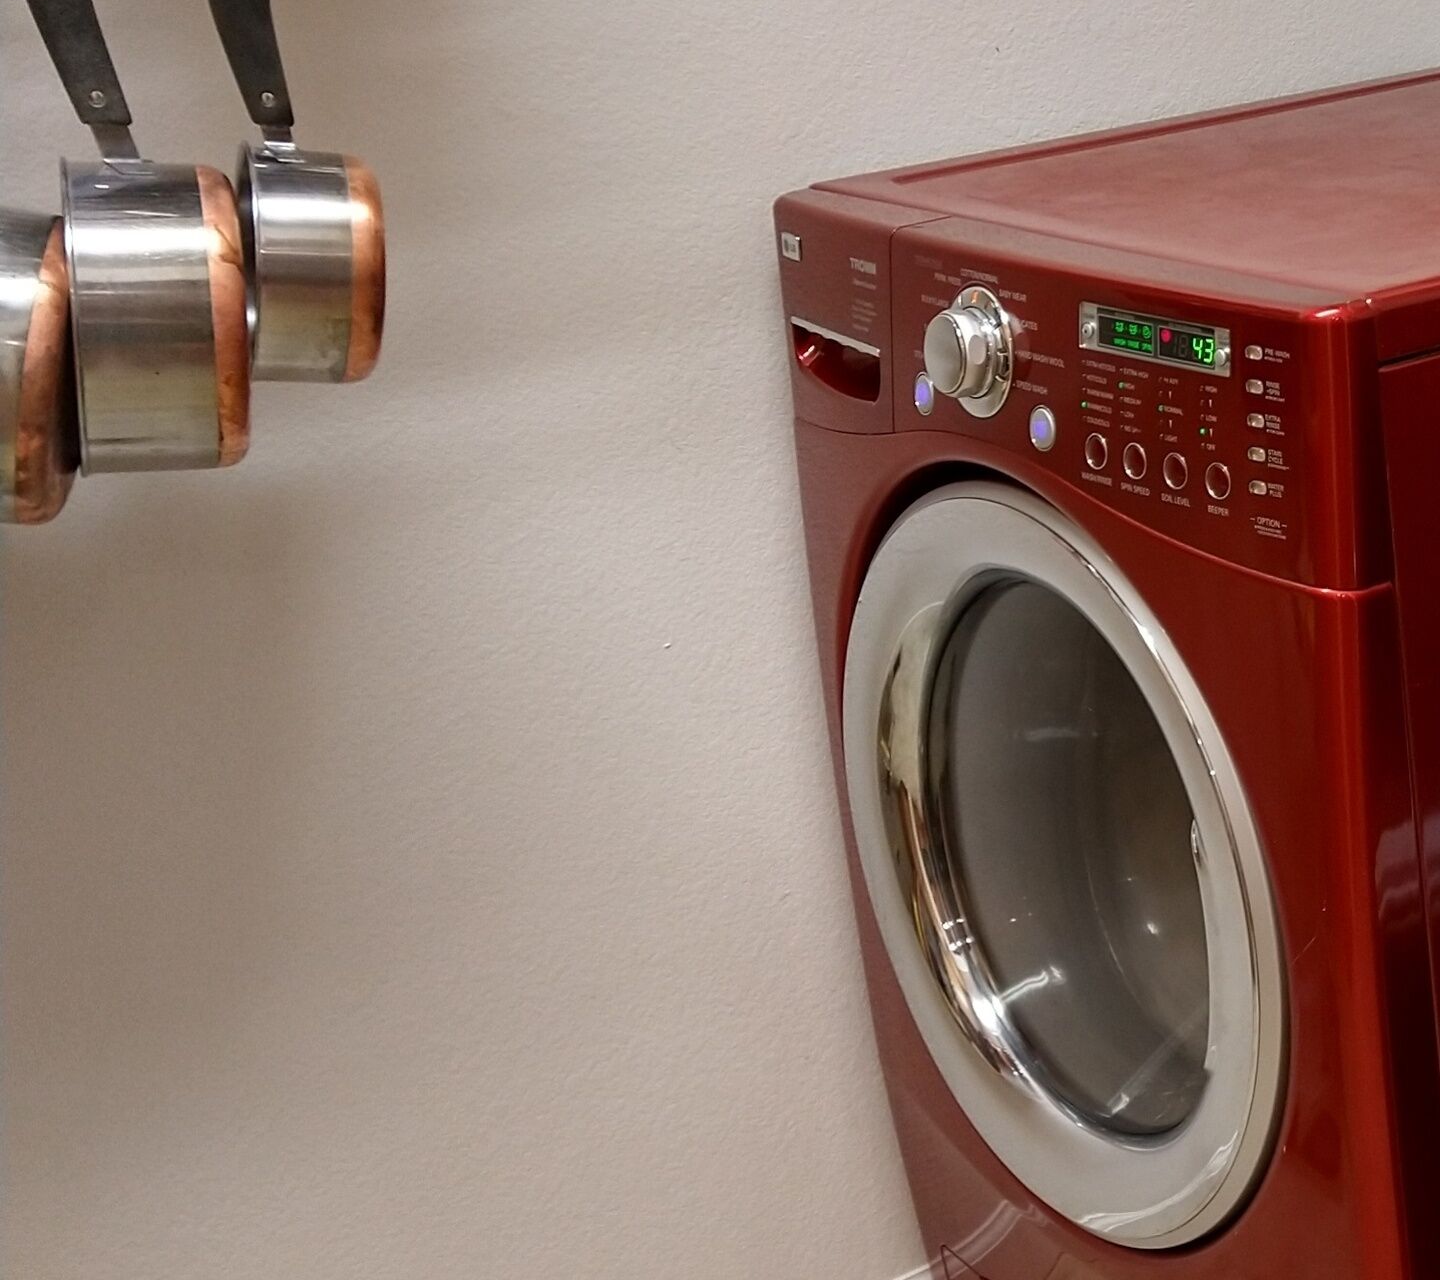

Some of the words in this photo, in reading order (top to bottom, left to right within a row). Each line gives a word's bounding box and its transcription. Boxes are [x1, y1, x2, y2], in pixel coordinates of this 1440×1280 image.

[1192, 336, 1214, 363] 43
[1207, 504, 1229, 517] BEEPER
[1257, 516, 1280, 528] OPTION
